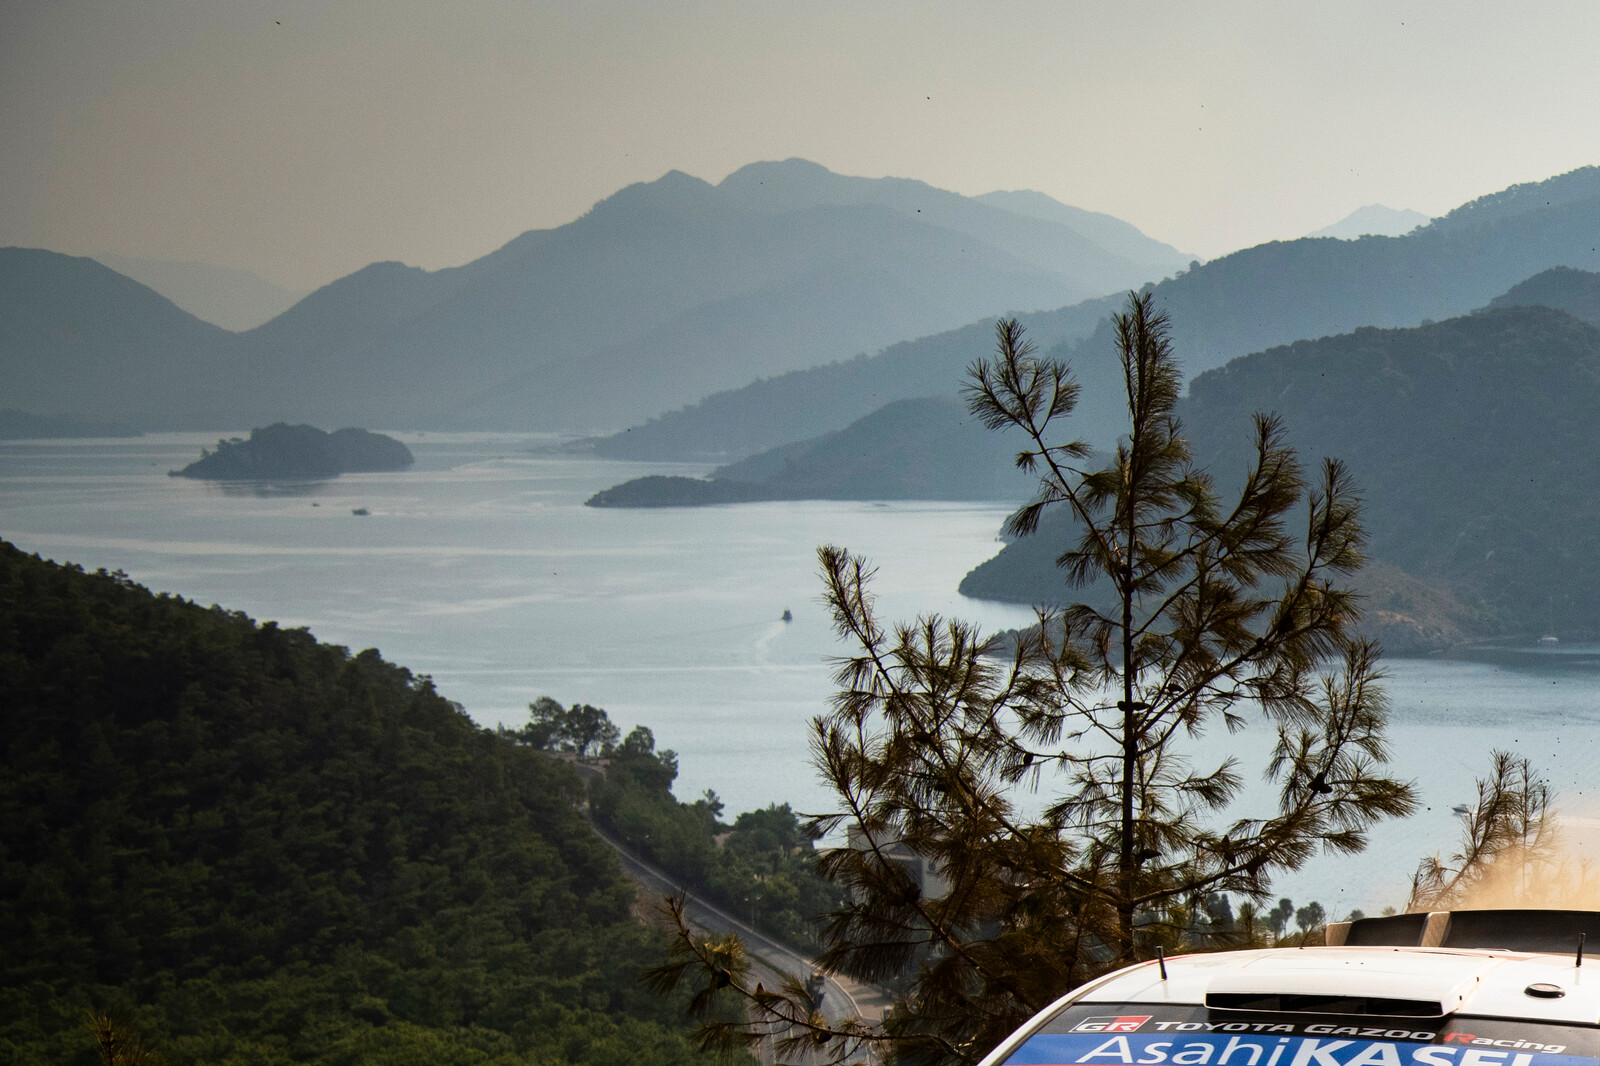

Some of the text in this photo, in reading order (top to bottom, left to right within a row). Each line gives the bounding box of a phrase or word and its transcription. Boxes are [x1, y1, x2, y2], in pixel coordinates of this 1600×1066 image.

[1075, 1021, 1567, 1054] GR TOYOTA GAZOO Racing
